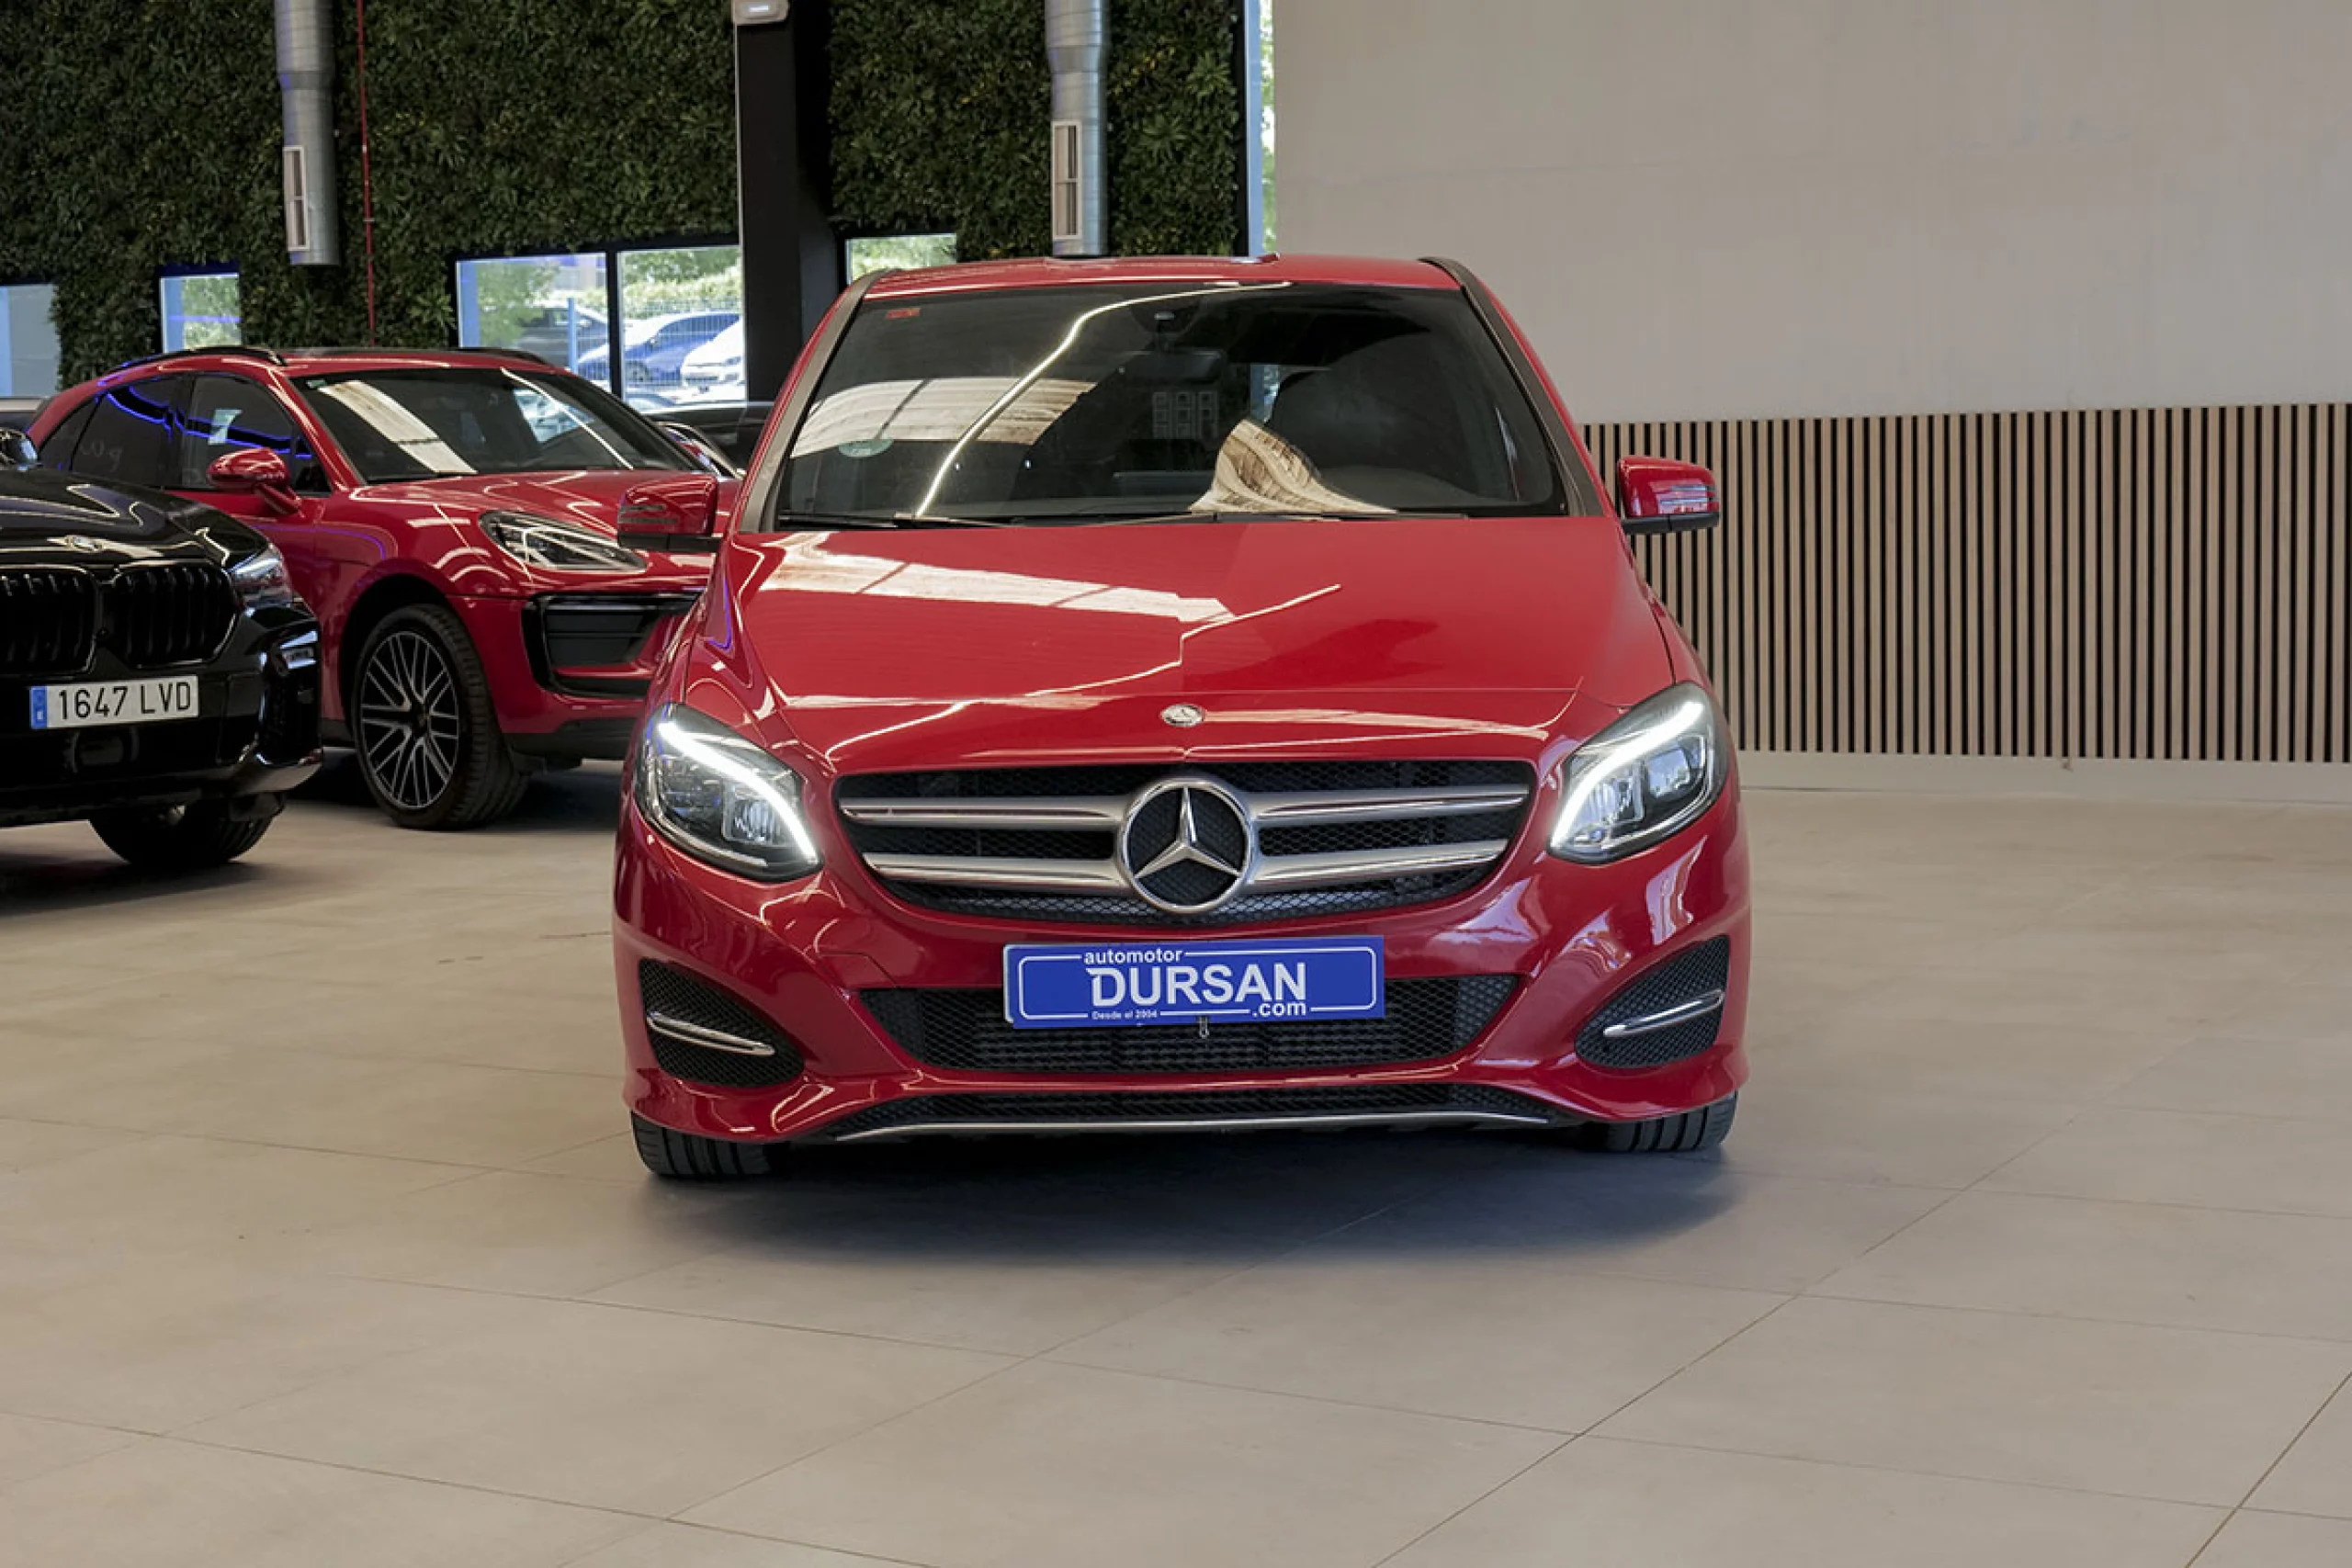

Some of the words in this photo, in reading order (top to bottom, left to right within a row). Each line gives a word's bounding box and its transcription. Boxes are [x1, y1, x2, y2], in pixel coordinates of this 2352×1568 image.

[59, 686, 128, 719] 1647
[141, 682, 190, 714] LVD
[1084, 948, 1182, 964] automotor
[1085, 963, 1306, 1007] DURSAN
[1252, 1001, 1306, 1017] .com
